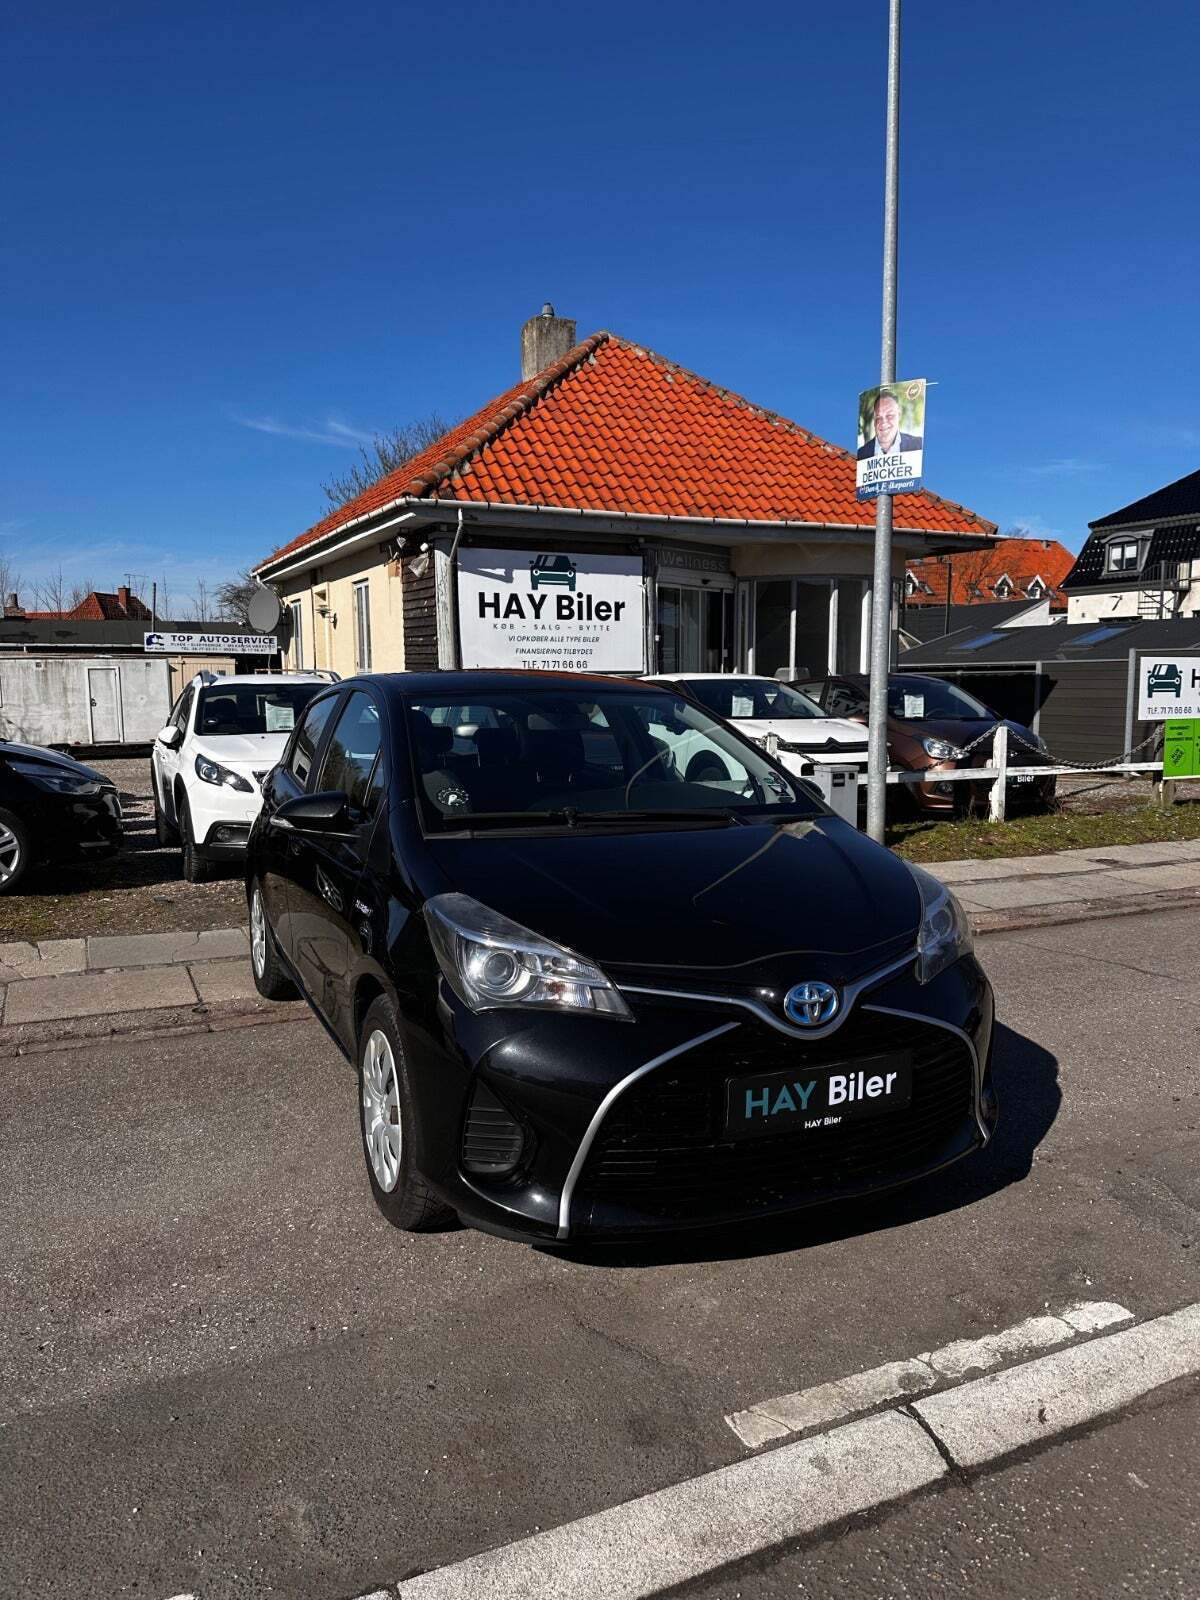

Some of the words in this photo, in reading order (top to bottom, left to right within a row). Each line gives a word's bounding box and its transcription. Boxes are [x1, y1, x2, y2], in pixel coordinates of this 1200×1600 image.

[867, 455, 906, 471] MIKKEL
[862, 466, 913, 484] DENCKER
[662, 550, 725, 571] Wellness
[478, 592, 548, 620] HAY
[556, 592, 626, 622] Biler
[171, 634, 193, 642] TOP
[199, 635, 275, 645] AUTOSERVICE
[515, 647, 562, 655] FINANSIERING
[541, 660, 550, 669] 71
[552, 660, 560, 669] 71
[562, 660, 574, 669] 66
[576, 660, 588, 669] 66
[745, 1080, 817, 1119] HAY
[828, 1071, 897, 1106] Biler
[804, 1118, 823, 1129] HAY
[824, 1116, 842, 1126] Biler
